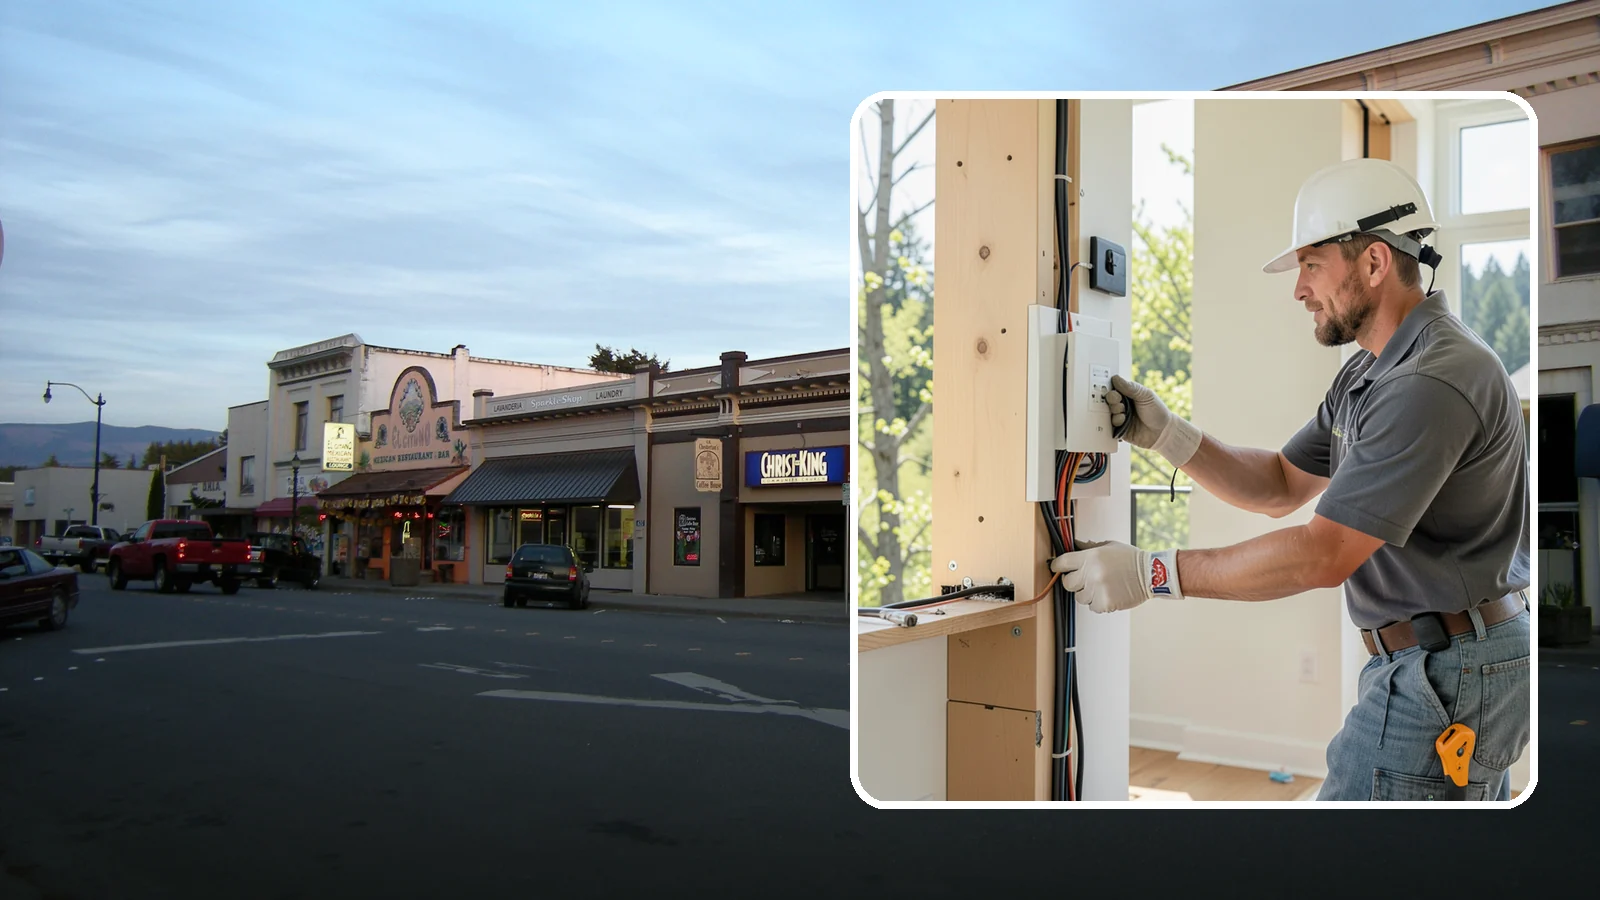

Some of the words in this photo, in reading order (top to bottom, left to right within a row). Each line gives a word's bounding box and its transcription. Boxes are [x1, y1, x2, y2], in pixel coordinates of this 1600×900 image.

[561, 394, 582, 405] Shop
[595, 389, 623, 400] LAUNDRY
[493, 402, 523, 413] LAVANDERIA
[397, 452, 433, 462] RESTAURANT
[437, 450, 450, 459] BAR
